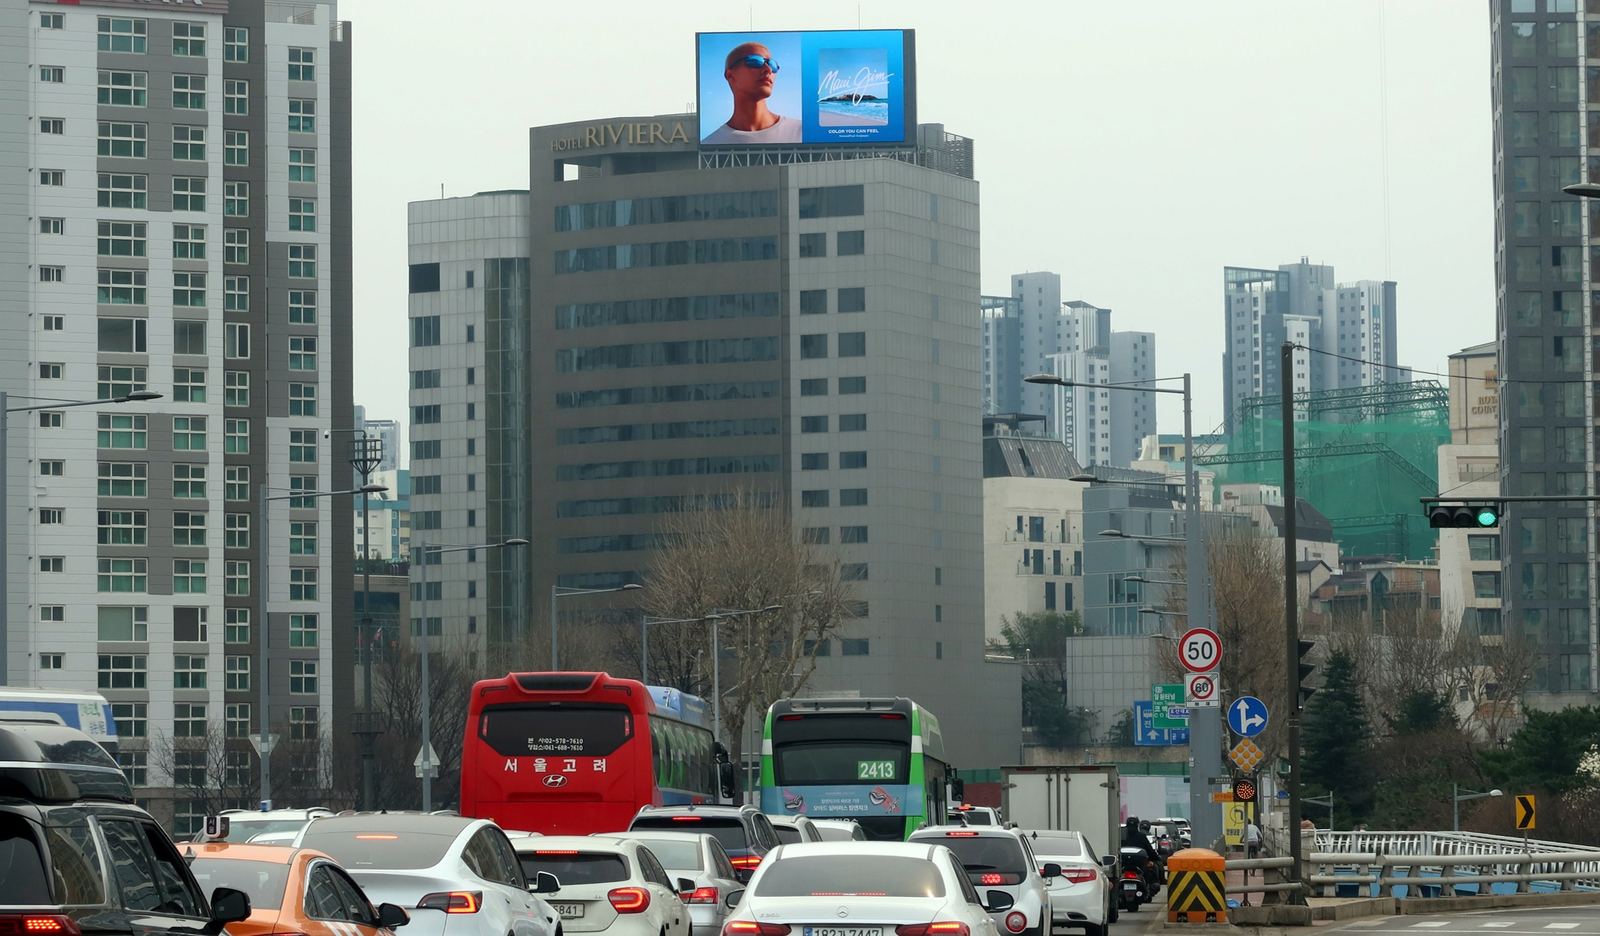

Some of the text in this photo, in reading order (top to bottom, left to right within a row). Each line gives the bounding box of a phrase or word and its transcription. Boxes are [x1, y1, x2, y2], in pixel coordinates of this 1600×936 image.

[817, 70, 852, 96] Maui
[551, 122, 689, 152] HOTEL RIVIERA
[1188, 641, 1212, 660] 50
[1195, 683, 1208, 693] 60
[860, 762, 893, 778] 2413
